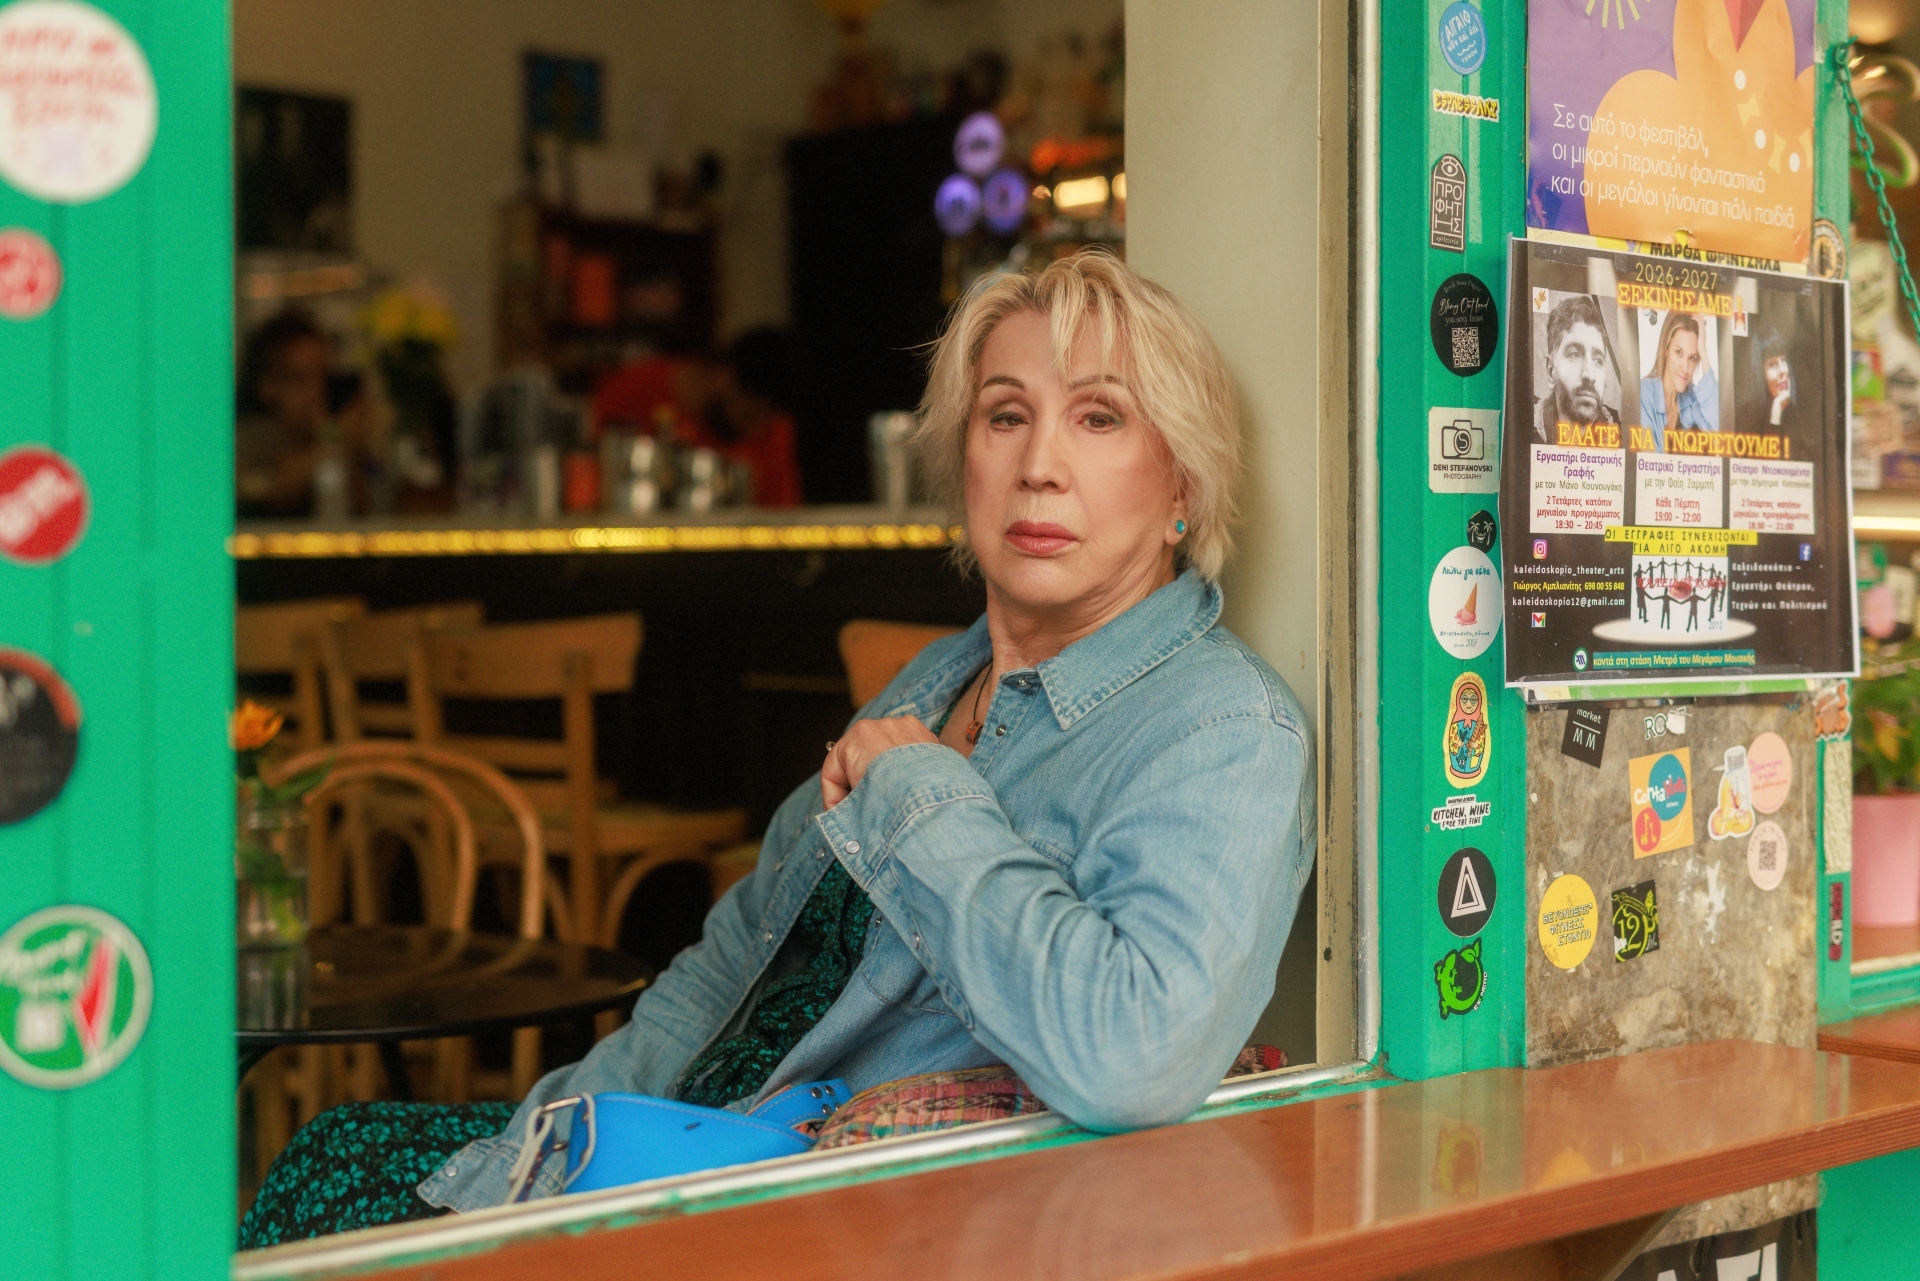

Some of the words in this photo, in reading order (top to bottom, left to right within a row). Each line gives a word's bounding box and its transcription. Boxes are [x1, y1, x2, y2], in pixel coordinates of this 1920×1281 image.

[1444, 9, 1471, 42] ΑΙΓΑΙΟ
[1553, 103, 1575, 129] Σε
[1579, 112, 1616, 136] αυτό
[1619, 121, 1636, 139] το
[1639, 118, 1709, 158] φεστιβάλ,
[1552, 143, 1567, 160] οι
[1571, 145, 1618, 172] μικροί
[1622, 153, 1687, 179] περνούν
[1689, 159, 1765, 193] φανταστικά
[1551, 175, 1575, 195] και
[1579, 179, 1594, 198] οι
[1597, 179, 1659, 208] μεγάλοι
[1662, 186, 1719, 217] γίνονται
[1722, 196, 1752, 222] πάλι
[1754, 204, 1795, 229] παιδιά
[1635, 262, 1718, 291] 2026-2027
[1557, 423, 1620, 449] ΕΛΑΤΕ
[1630, 427, 1655, 450] ΝΑ
[1536, 450, 1578, 465] Εργαστήρι
[1580, 452, 1622, 467] Θεατρικής
[1433, 463, 1449, 471] DENI
[1449, 464, 1493, 473] STEFANOVSKI
[1563, 466, 1595, 480] Γραφής
[1638, 458, 1674, 475] Θεατρικό
[1677, 461, 1721, 477] Εργαστήρι
[1535, 481, 1544, 491] με
[1545, 481, 1556, 489] τον
[1559, 480, 1579, 490] Μάνο
[1644, 478, 1653, 489] με
[1654, 478, 1666, 490] την
[1546, 495, 1551, 505] 2
[1552, 495, 1582, 507] Τετάρτες
[1585, 497, 1612, 507] κατόπιν
[1655, 496, 1672, 508] Κάθε
[1674, 497, 1700, 511] Πέμπτη
[1536, 507, 1568, 518] μηνιαίου
[1570, 508, 1621, 520] προγράμματος
[1655, 511, 1673, 522] 19:00
[1682, 512, 1702, 523] 22:00
[1555, 519, 1574, 529] 18:30
[1584, 520, 1603, 530] 20:45
[1605, 529, 1616, 539] ΟΙ
[1625, 530, 1675, 541] ΕΓΓΡΑΦΕΣ
[1682, 531, 1750, 542] ΣΥΝΕΧΙΖΟΝΤΑΙ
[1633, 543, 1650, 553] ΓΙΑ
[1659, 543, 1682, 554] ΛΙΓΟ
[1690, 544, 1726, 554] ΑΚΟΜΗ
[1513, 564, 1625, 577] kaleidoskopio_theater_arts
[1513, 580, 1542, 592] Γιώργος
[1542, 580, 1582, 592] Αμπλιανίτης
[1584, 581, 1596, 591] 698
[1596, 581, 1604, 591] 00
[1605, 581, 1613, 591] 55
[1613, 581, 1625, 591] 848
[1512, 596, 1625, 608] kaleidoskopio12@gmail.com
[1761, 601, 1776, 610] και
[1708, 620, 1723, 630] 2012
[1593, 655, 1615, 666] κοντά
[1615, 657, 1629, 667] στη
[1629, 655, 1652, 667] στάση
[1653, 653, 1678, 667] Μετρό
[1679, 655, 1691, 665] του
[1691, 653, 1723, 667] Μεγάρου
[1576, 708, 1602, 724] market
[1433, 807, 1467, 821] KITCHEN,
[1469, 803, 1490, 816] WINE
